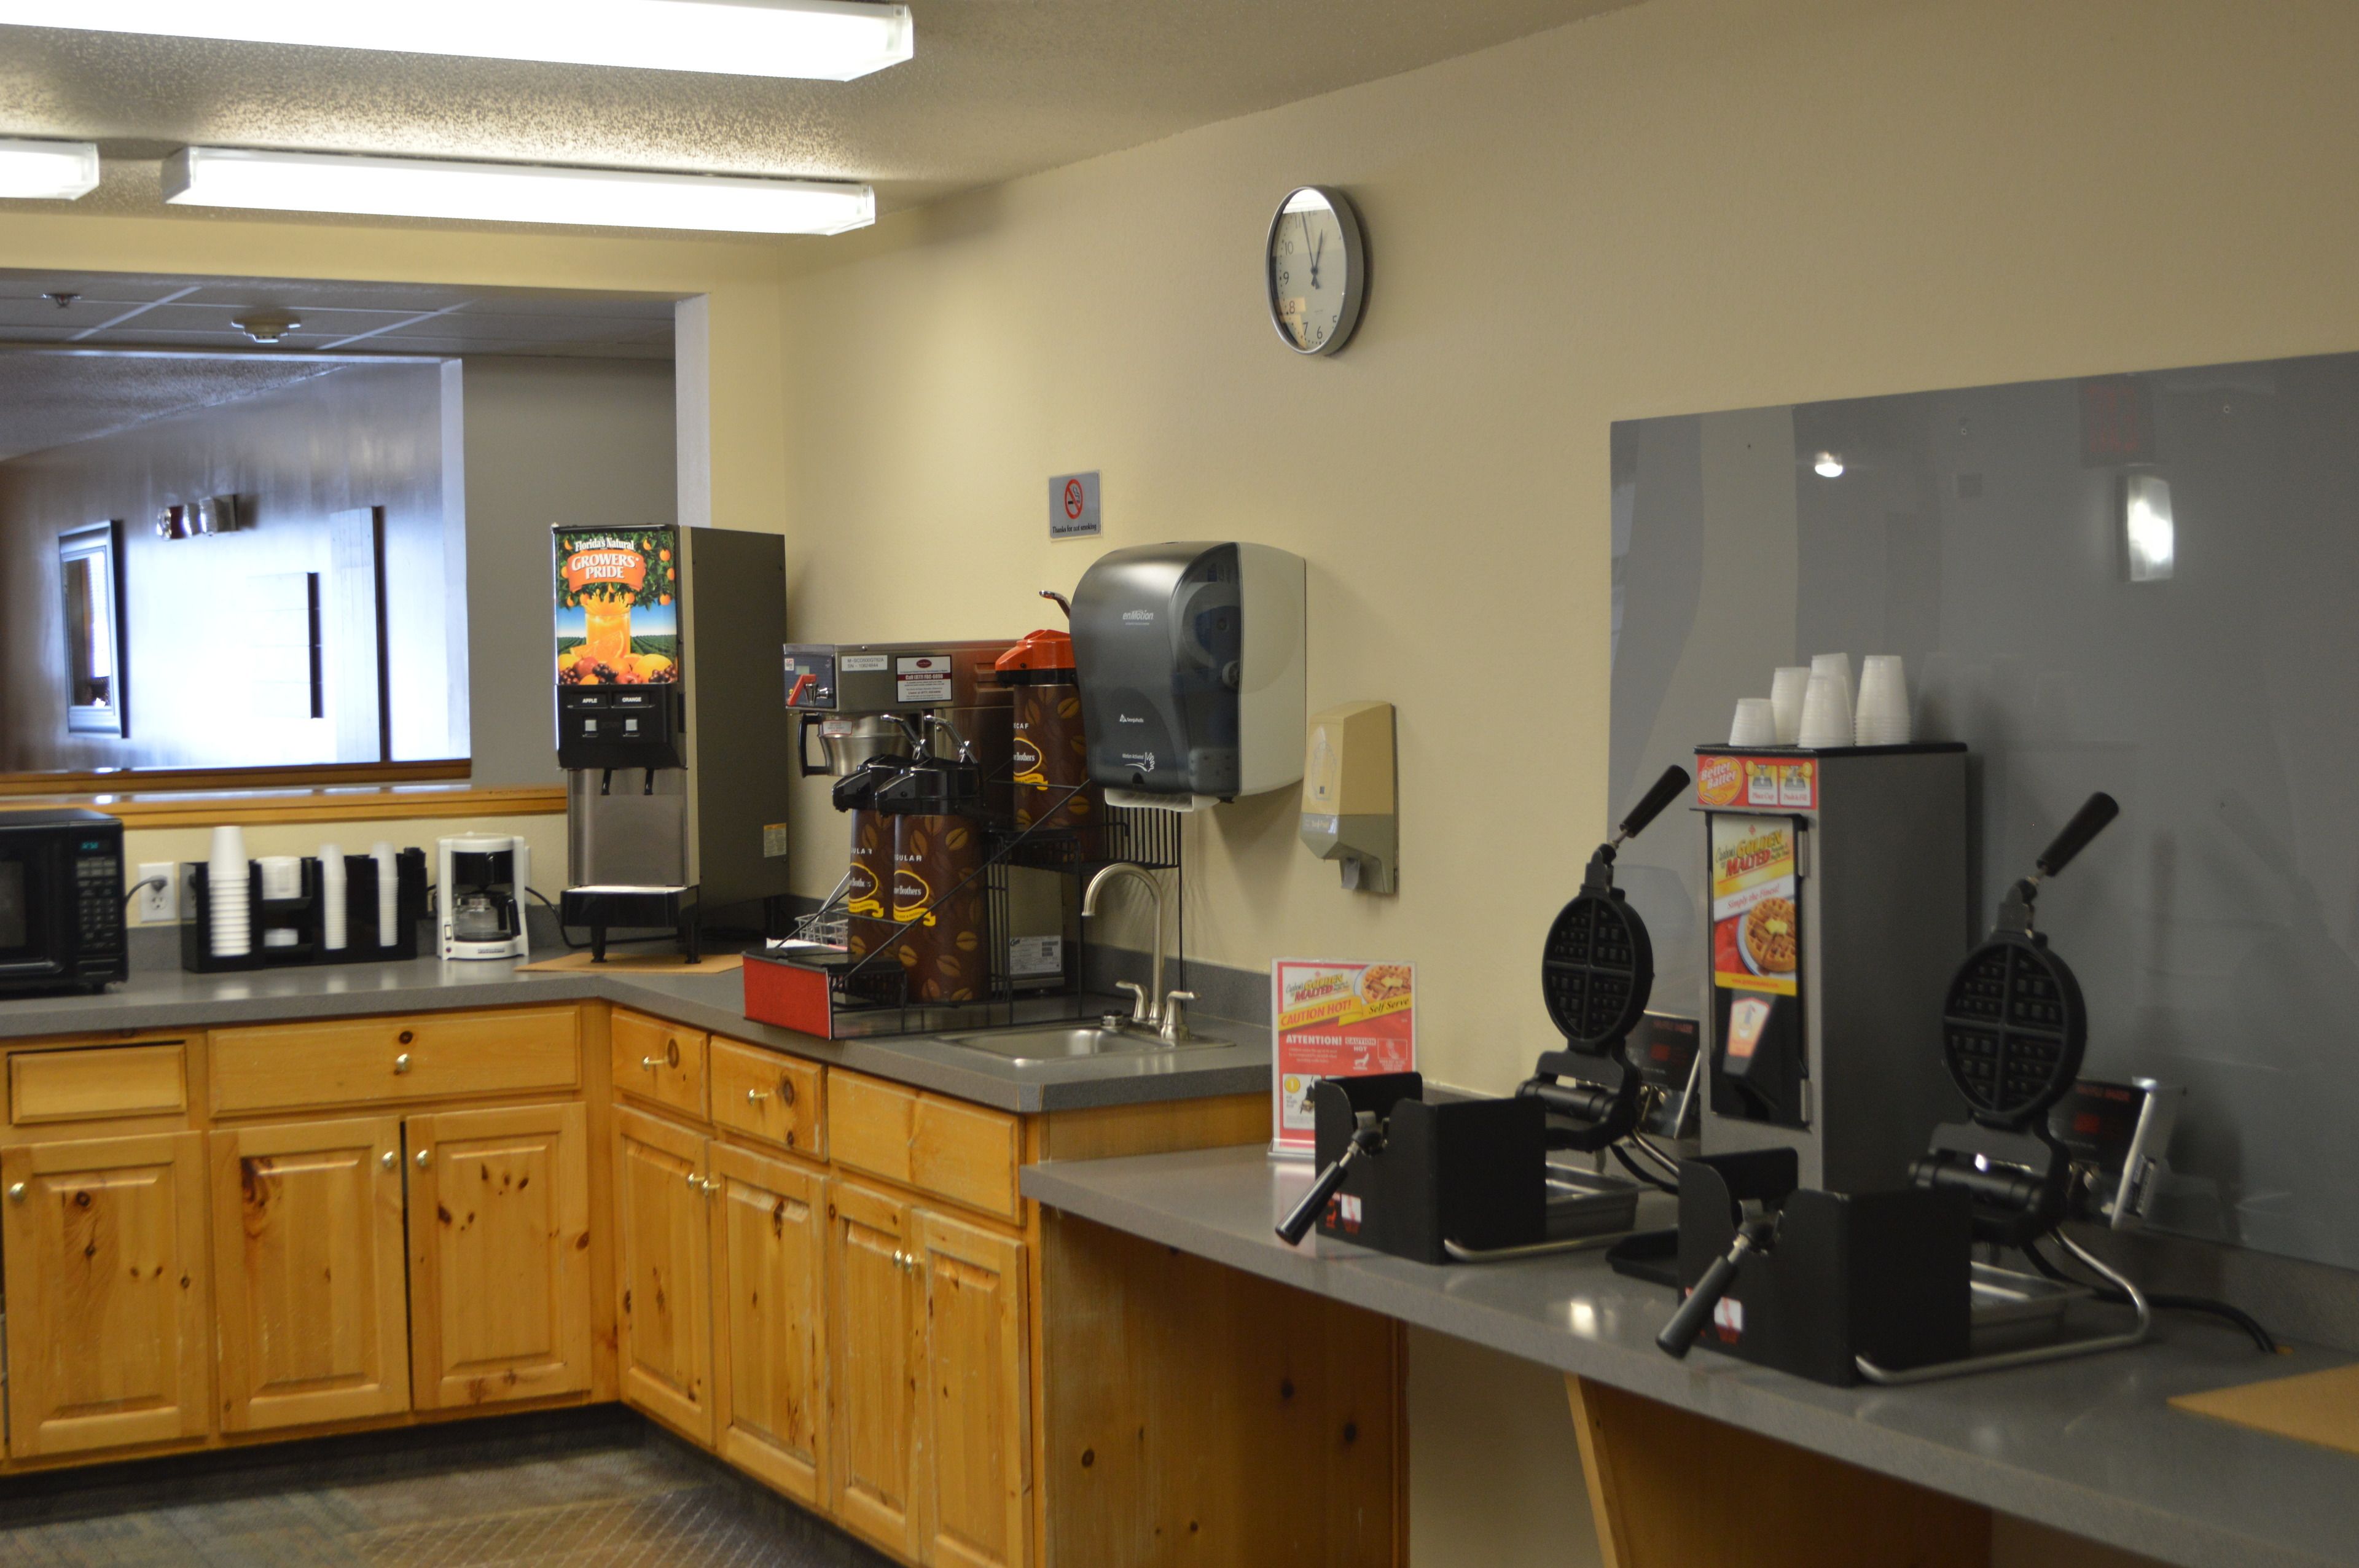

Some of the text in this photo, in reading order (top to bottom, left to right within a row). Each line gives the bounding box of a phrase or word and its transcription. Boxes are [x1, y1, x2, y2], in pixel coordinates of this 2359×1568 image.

[1285, 241, 1294, 255] 10
[1283, 271, 1289, 285] 9
[1289, 300, 1296, 314] 8
[1302, 322, 1309, 335] 7
[1316, 326, 1323, 339] 6
[575, 536, 635, 552] Florida's Natural
[585, 566, 625, 580] PRIDE
[1701, 762, 1731, 781] Better
[1707, 771, 1736, 790] Batter
[1737, 829, 1782, 859] GOLDEN
[1725, 848, 1771, 877] MALTED
[899, 885, 921, 895] Brothers
[1727, 896, 1748, 909] Simply
[1749, 892, 1758, 901] the
[1304, 973, 1344, 990] GOLDEN
[1294, 984, 1334, 1002] MALTED
[1280, 999, 1352, 1027] CAUTION HOT!
[1369, 998, 1409, 1015] Self Serve
[1286, 1034, 1342, 1046] ATTENTION!
[1345, 1037, 1376, 1046] CAUTION
